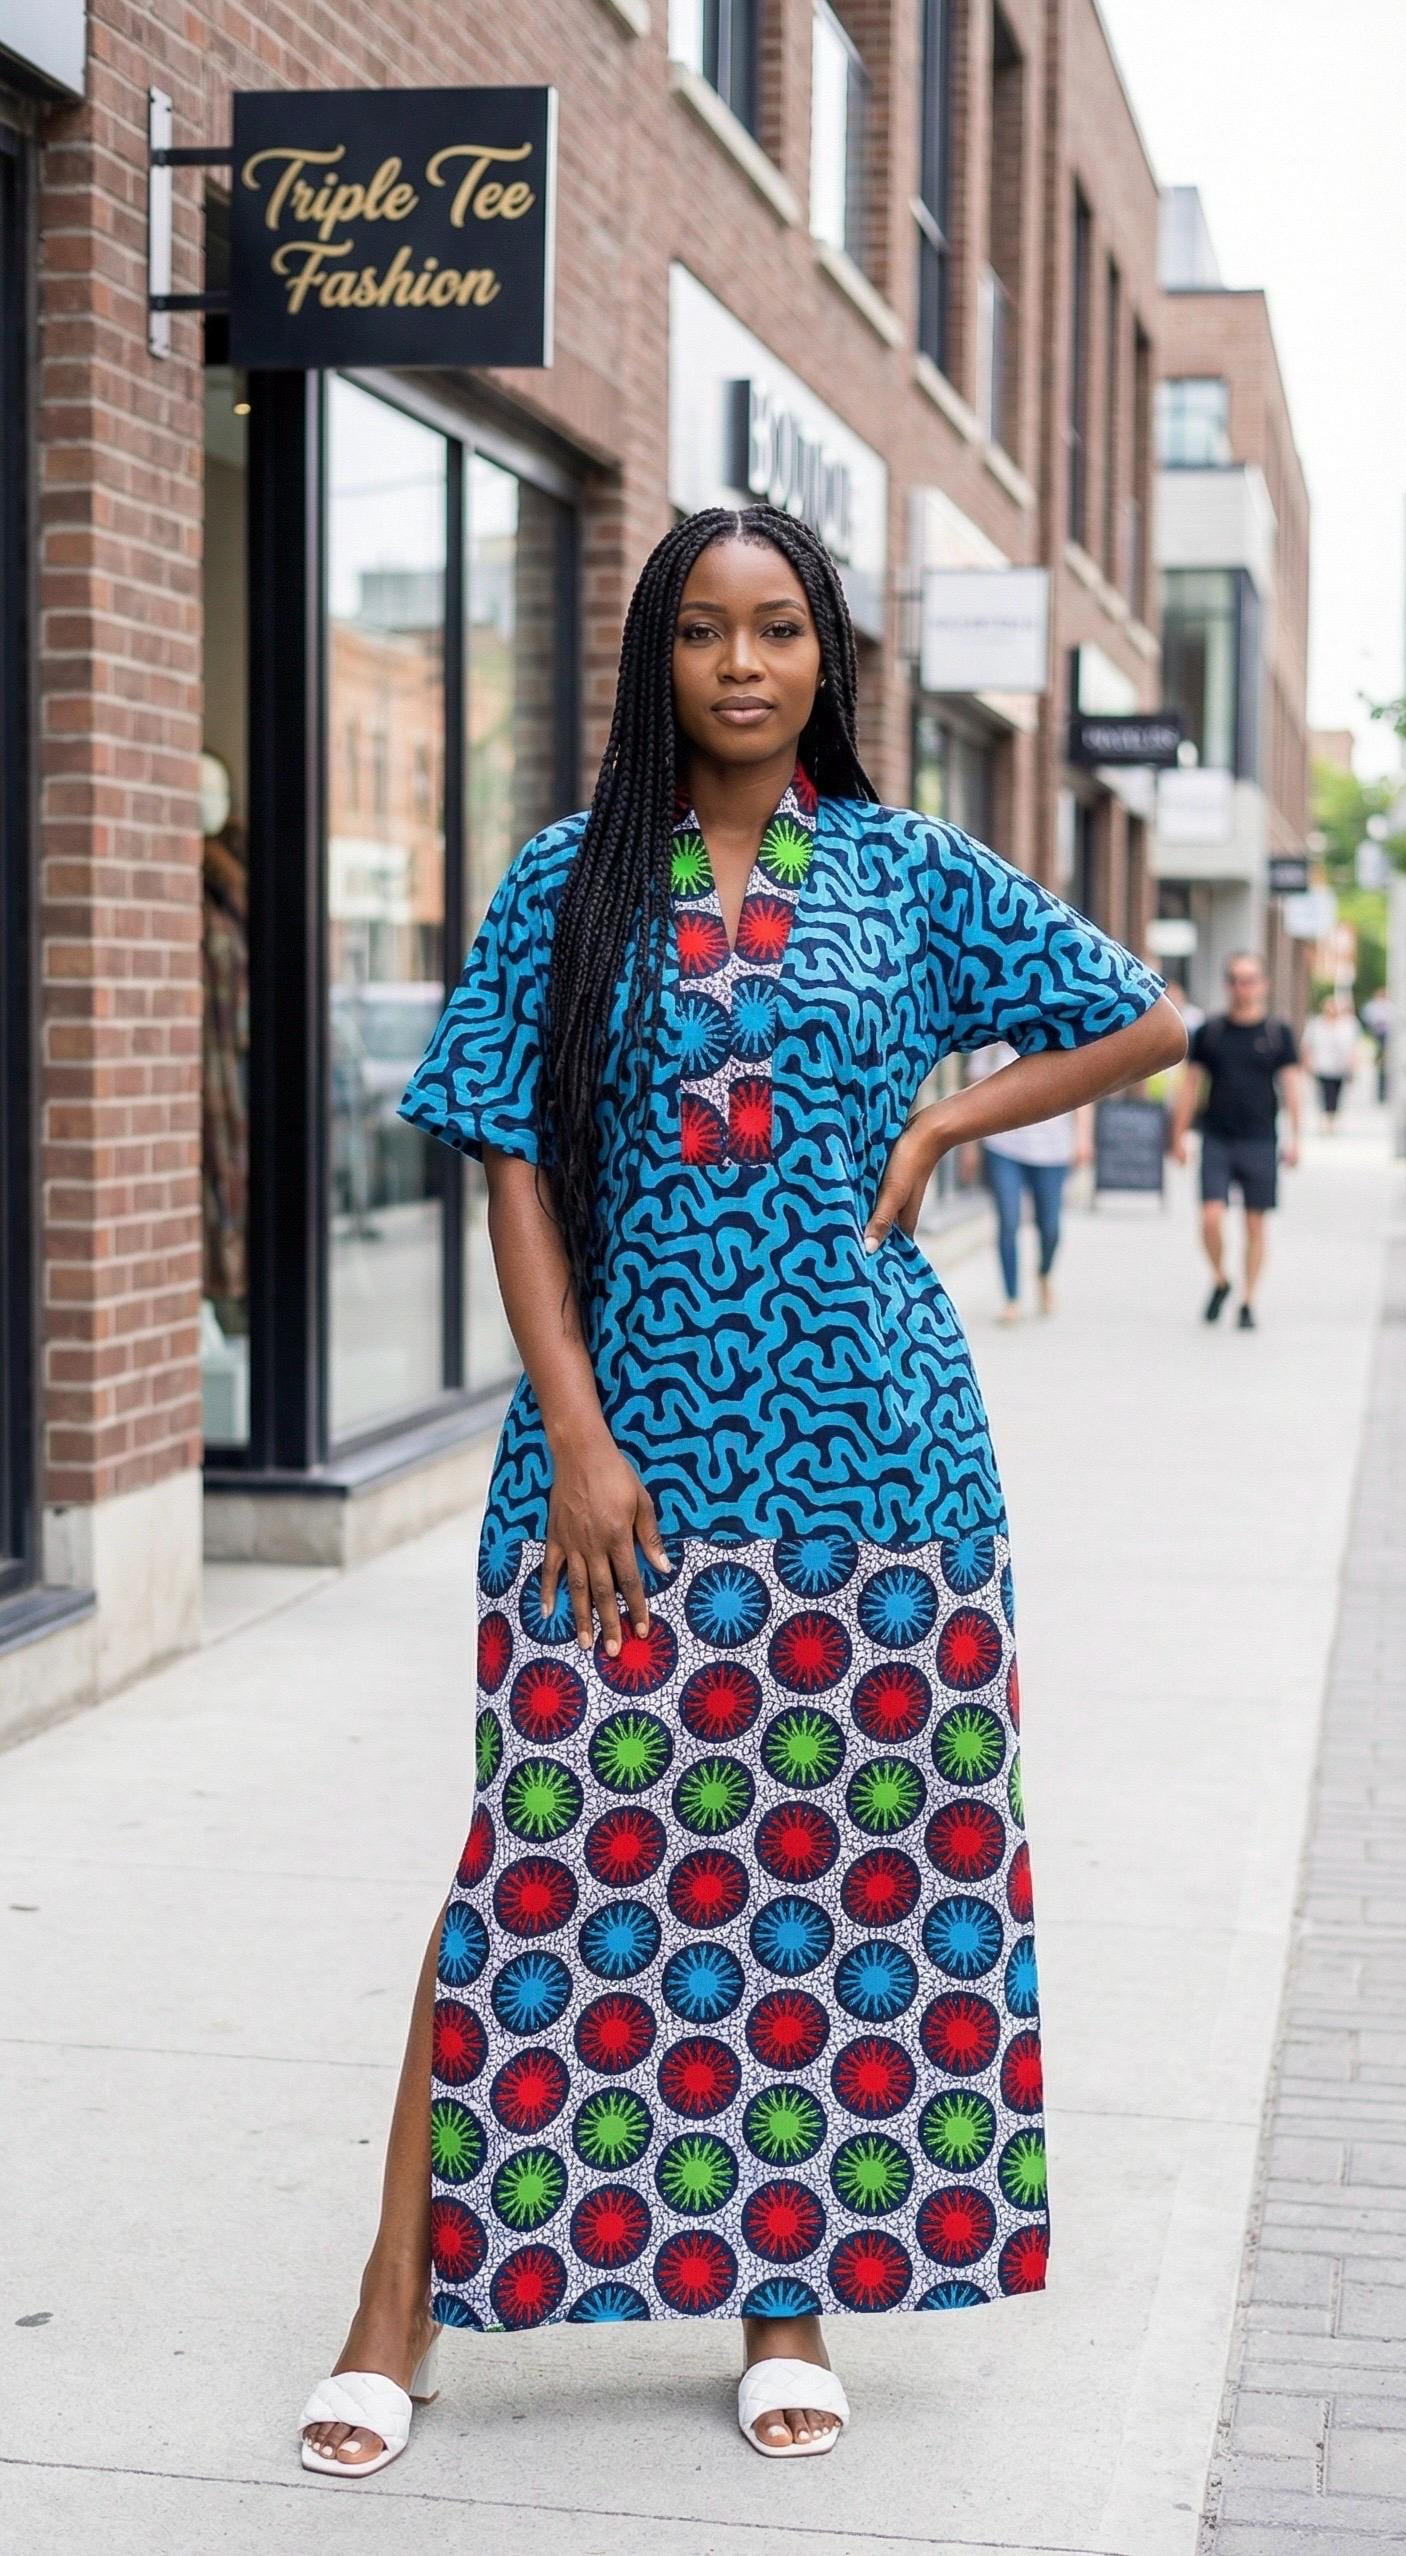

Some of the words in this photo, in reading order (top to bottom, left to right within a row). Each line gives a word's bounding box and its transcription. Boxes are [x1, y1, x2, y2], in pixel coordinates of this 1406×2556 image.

[241, 144, 418, 241] Triple
[425, 142, 535, 228] Tee
[271, 239, 500, 314] Fashion
